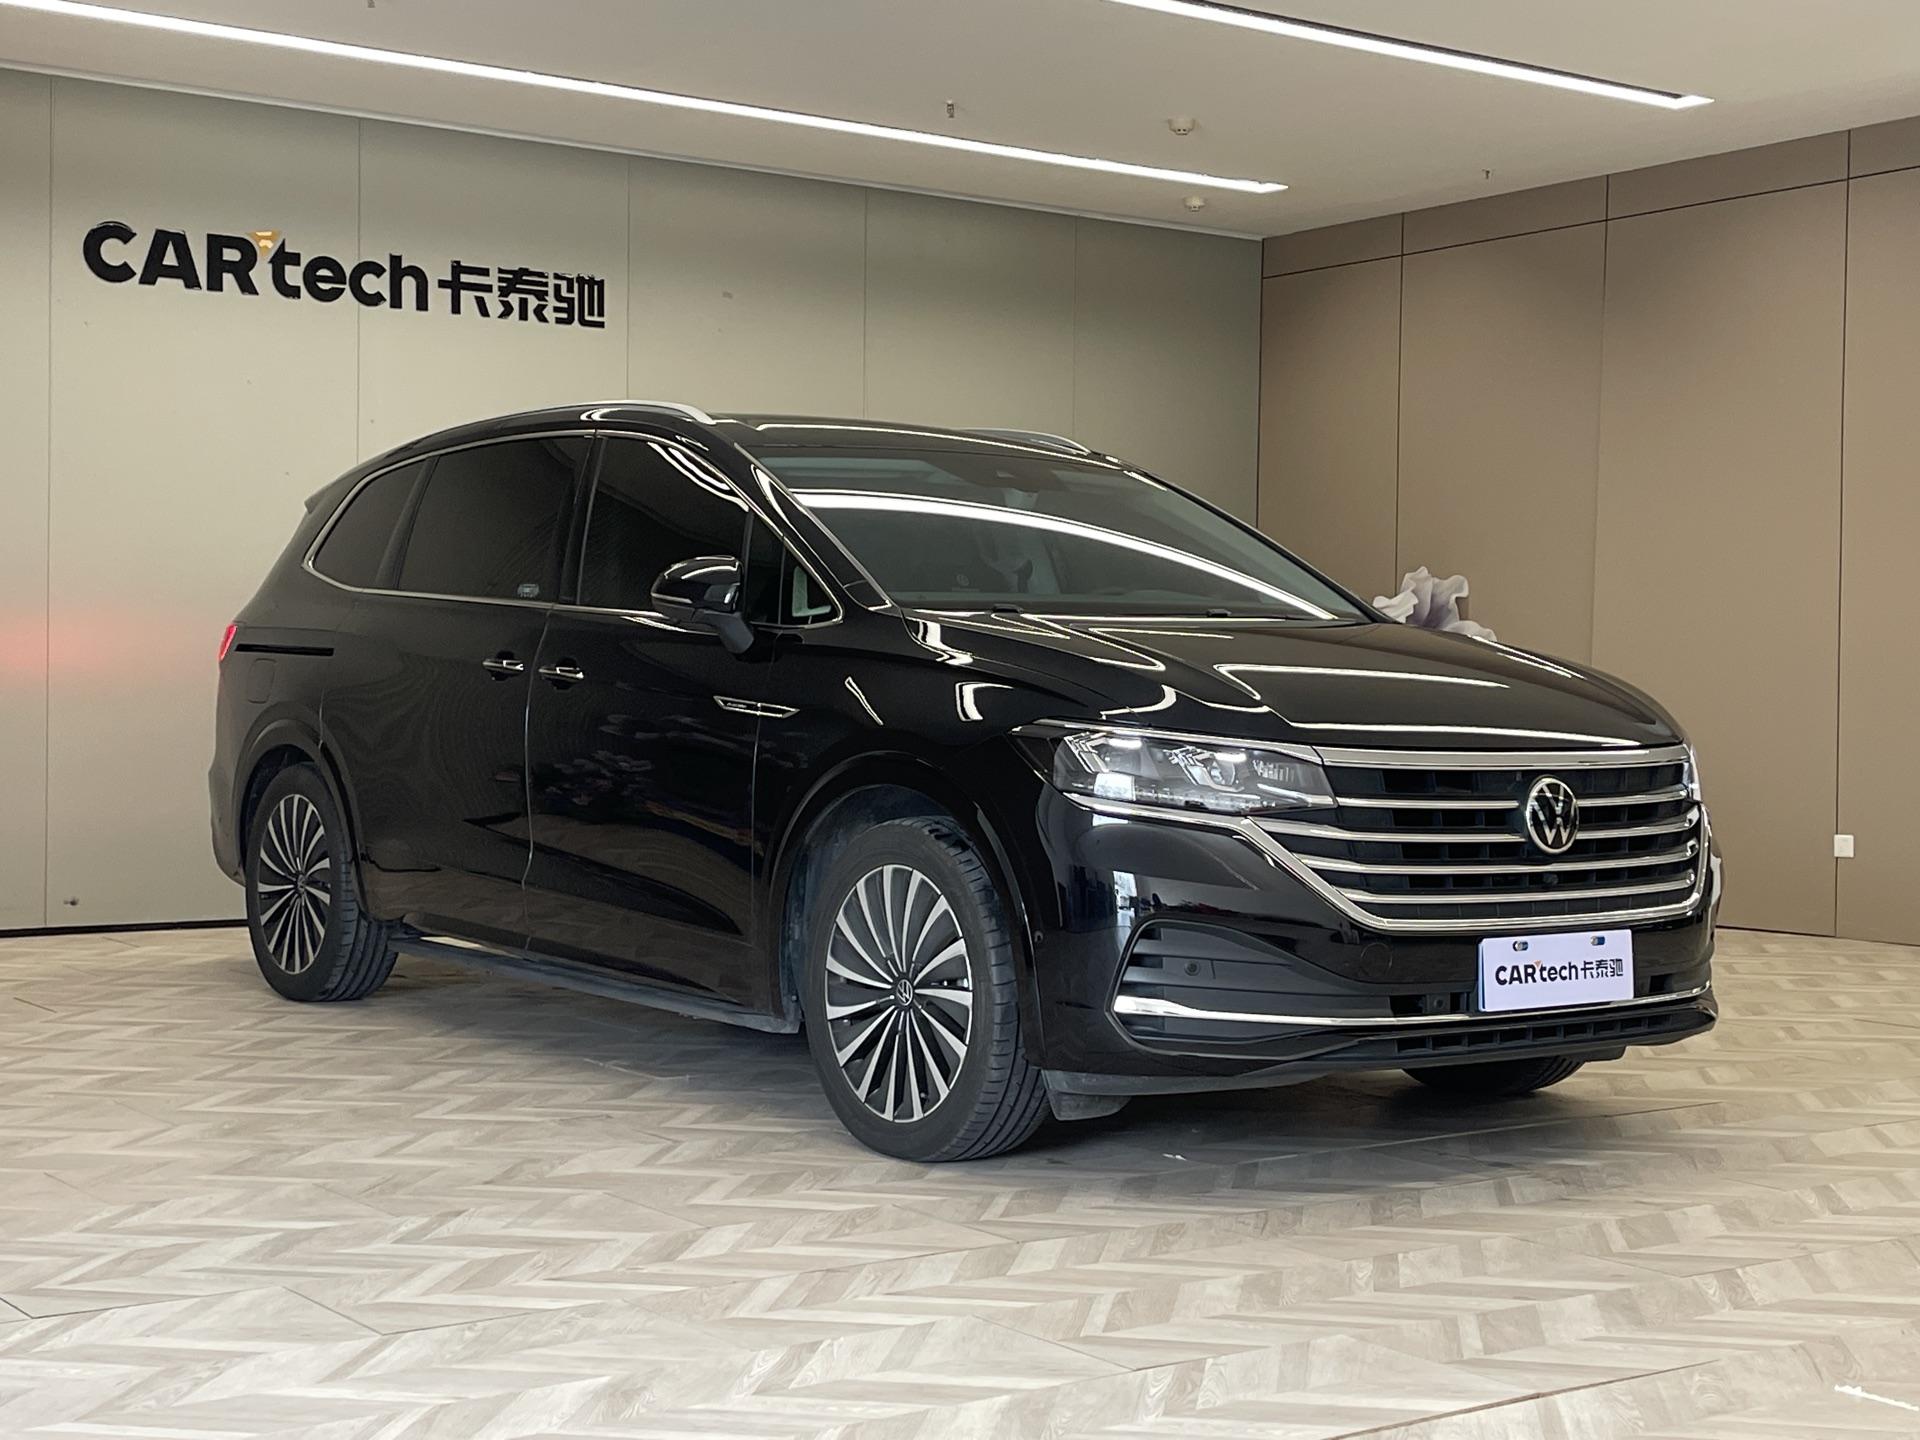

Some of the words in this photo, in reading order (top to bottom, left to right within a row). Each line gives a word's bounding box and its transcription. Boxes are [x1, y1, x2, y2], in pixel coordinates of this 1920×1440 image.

[83, 220, 429, 311] CARtech
[438, 260, 606, 329] 卡泰驰
[1495, 962, 1579, 985] CARtech
[1580, 958, 1624, 980] 卡泰驰
